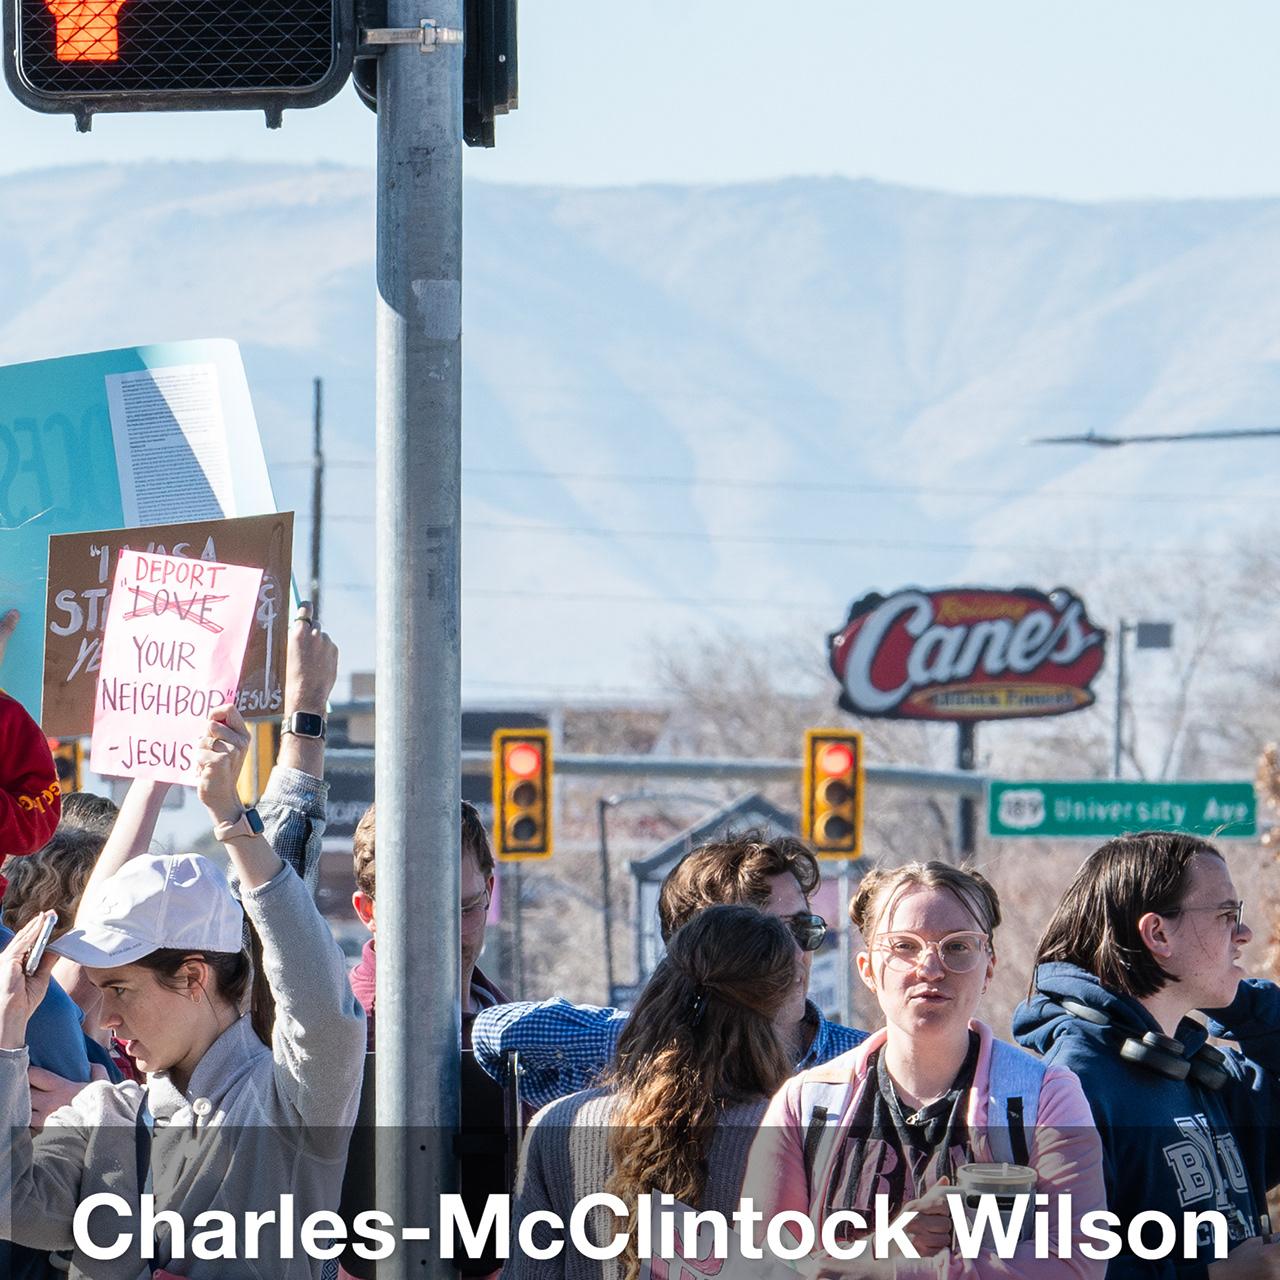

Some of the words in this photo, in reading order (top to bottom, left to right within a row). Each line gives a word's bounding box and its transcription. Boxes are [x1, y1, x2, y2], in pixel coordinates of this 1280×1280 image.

[136, 556, 227, 589] DEPORT
[133, 634, 195, 673] YOUR
[1054, 797, 1187, 825] University
[1203, 797, 1248, 821] Ave
[1163, 1113, 1248, 1208] BYU
